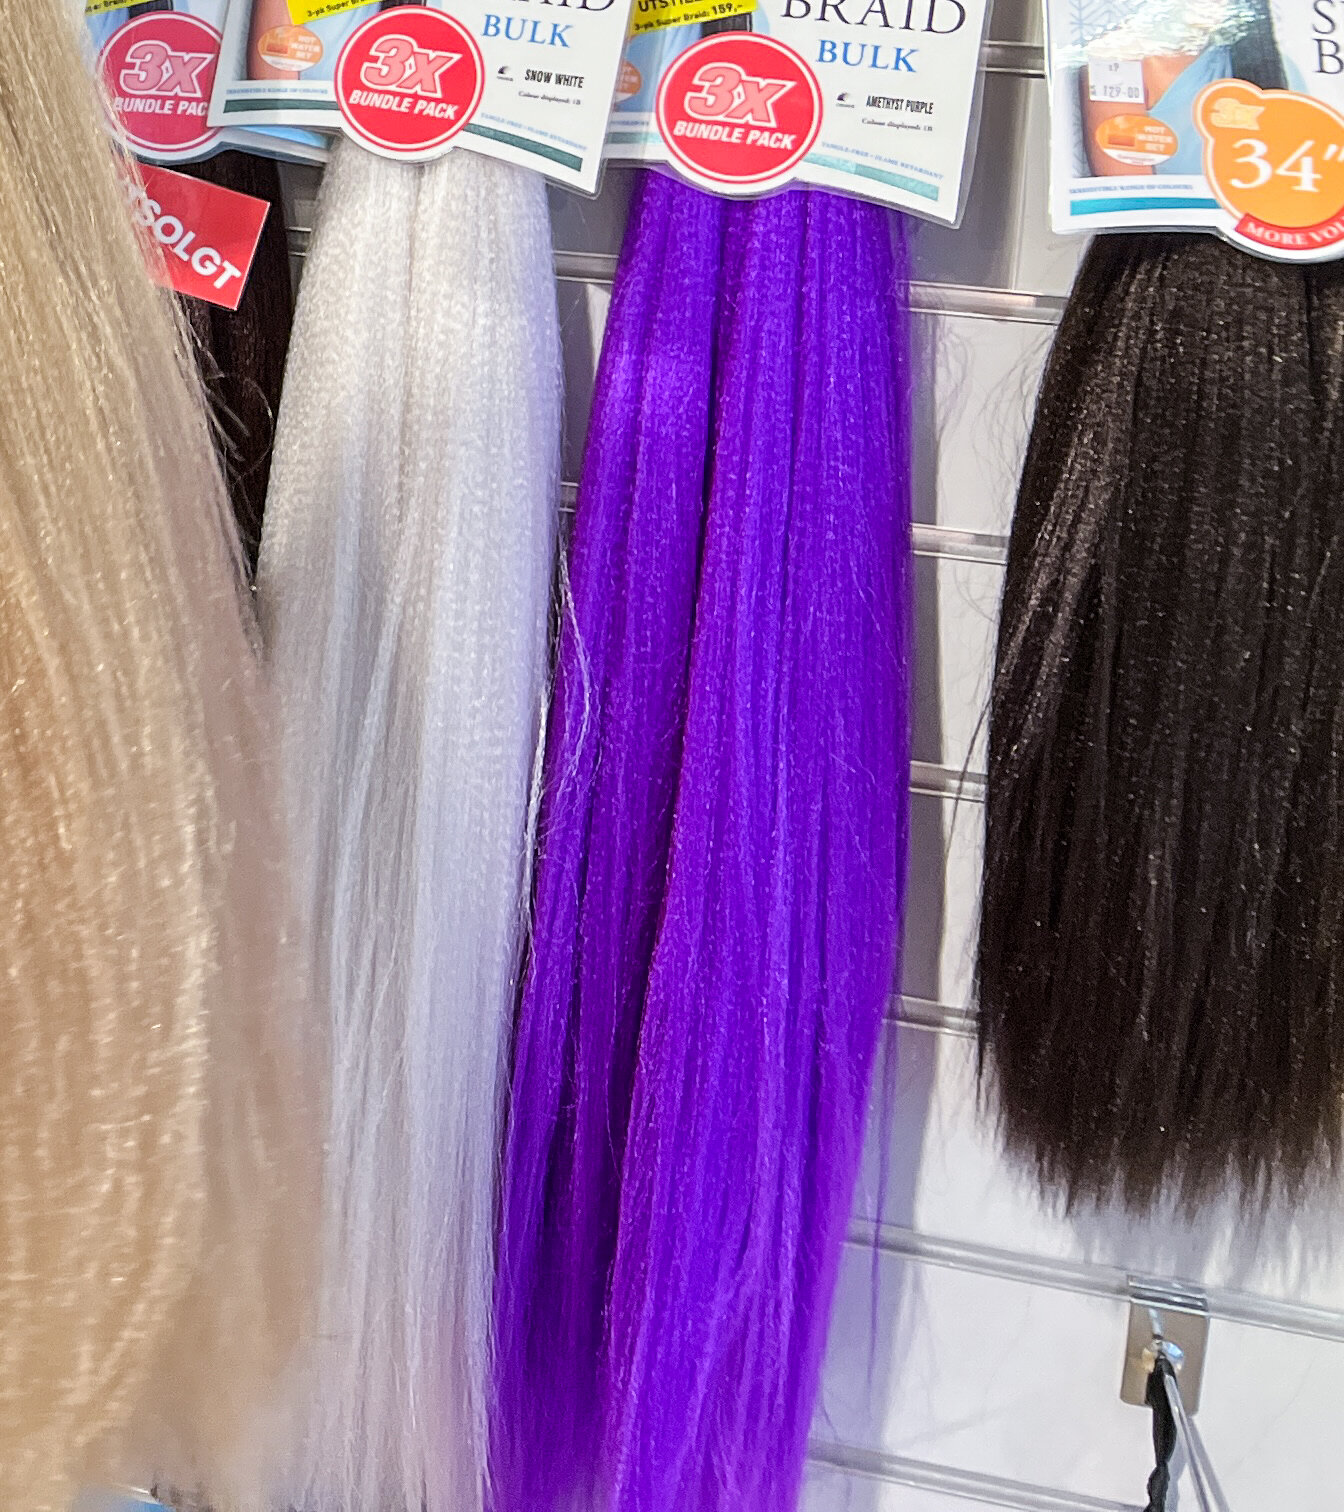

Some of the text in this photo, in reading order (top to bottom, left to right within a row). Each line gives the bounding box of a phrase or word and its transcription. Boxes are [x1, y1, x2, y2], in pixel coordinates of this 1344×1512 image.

[481, 14, 574, 48] BULK
[815, 39, 920, 73] BULK
[524, 69, 585, 88] SNOW WHITE
[113, 96, 209, 116] BUNDLE PAC
[349, 89, 460, 120] BUNDLE PACK
[865, 95, 934, 115] AMETHYST PURPLE
[673, 119, 797, 150] BUNDLE PACK
[129, 187, 242, 289] SOLGT
[1246, 221, 1308, 245] MORE
